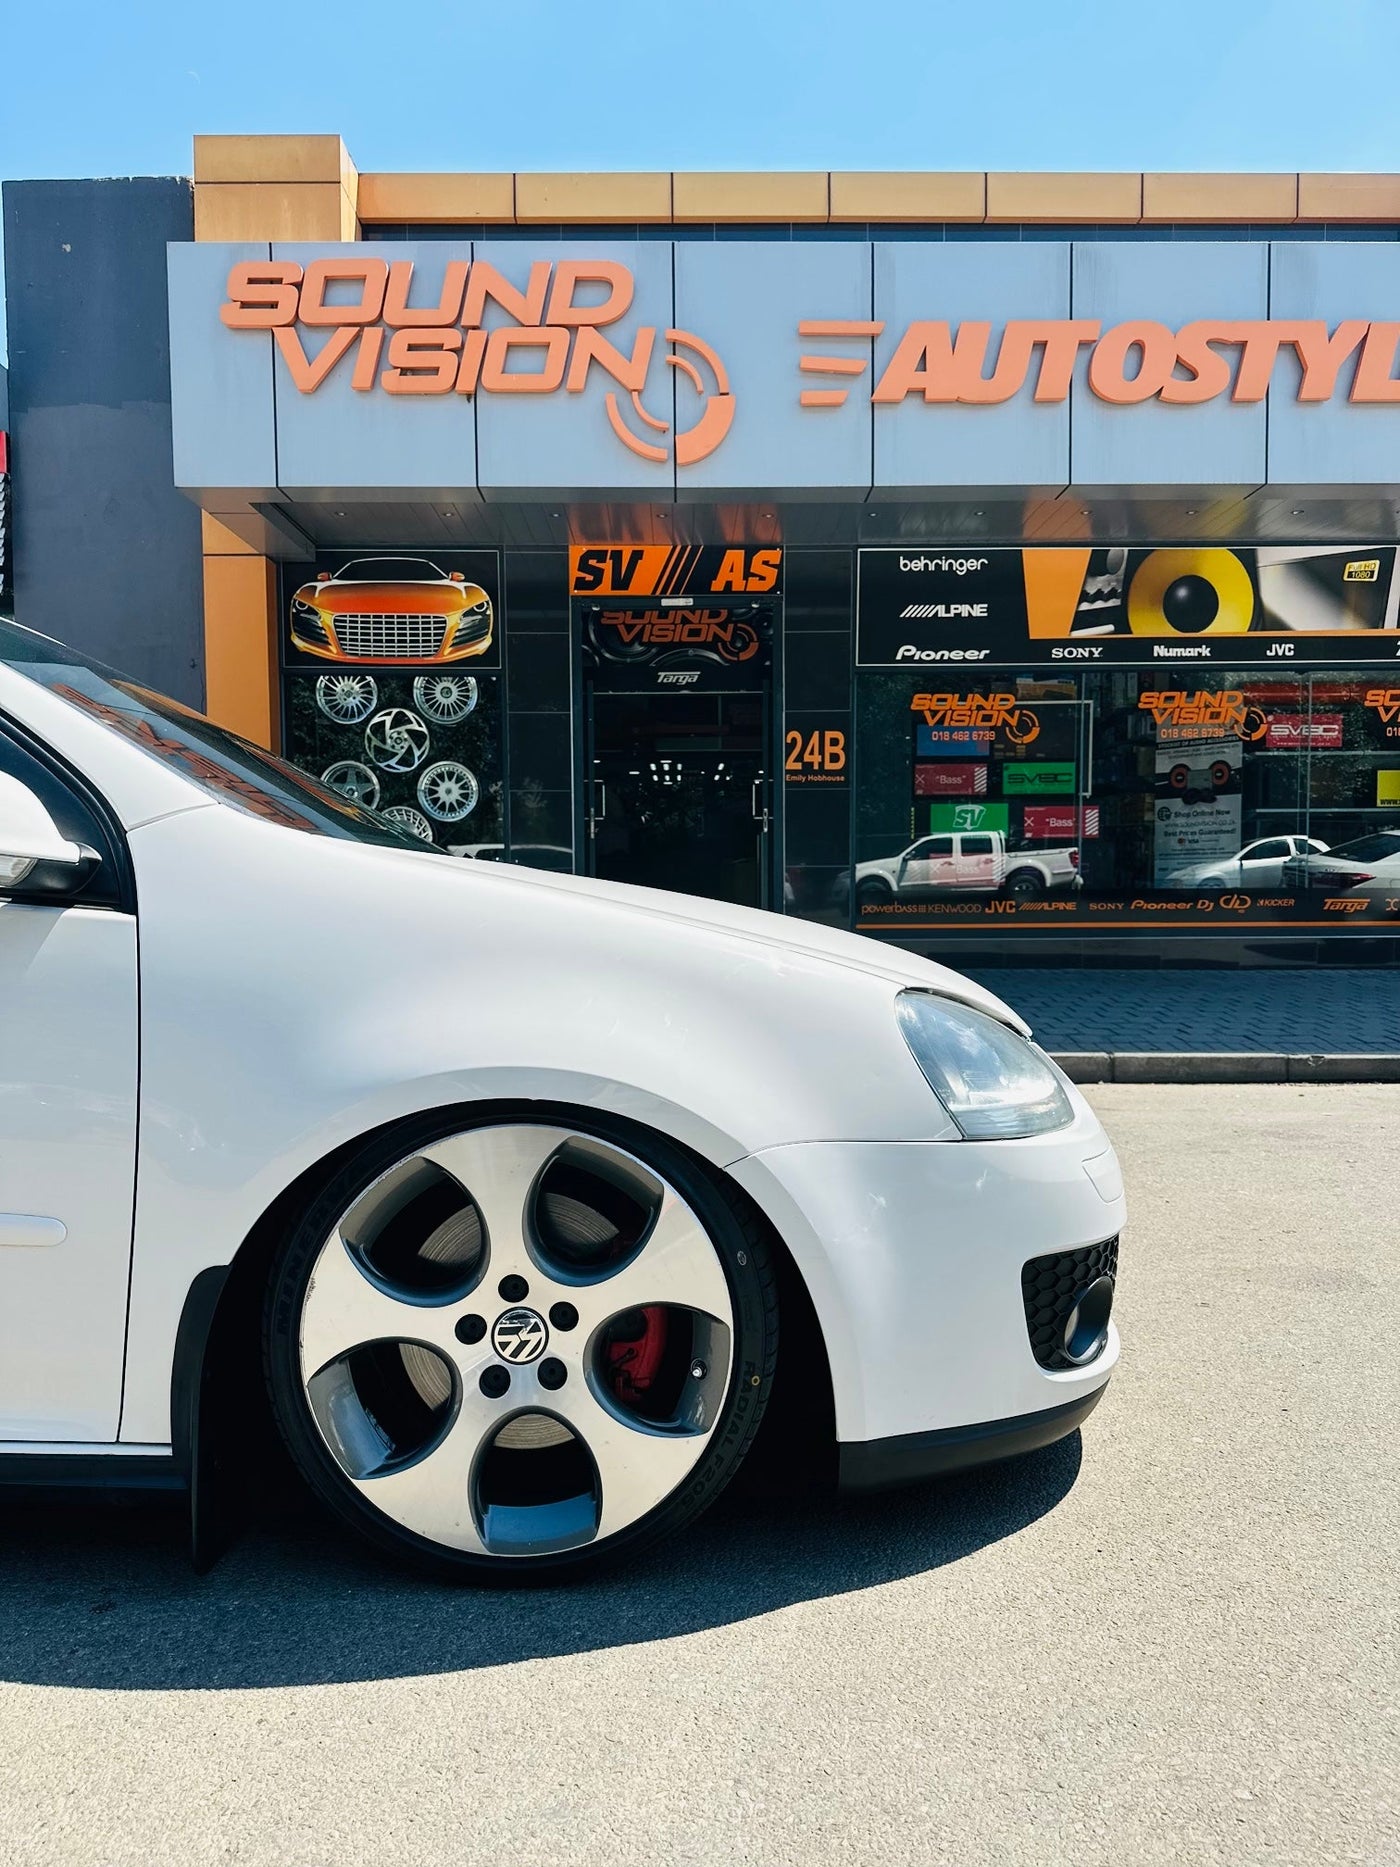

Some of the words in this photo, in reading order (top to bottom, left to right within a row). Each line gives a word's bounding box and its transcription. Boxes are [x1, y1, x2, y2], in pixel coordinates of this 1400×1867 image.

[219, 257, 634, 328] SOUND
[272, 325, 656, 394] VISION
[871, 320, 1400, 405] AUTOSTYL
[573, 549, 644, 591] SV
[710, 549, 783, 592] AS
[899, 556, 988, 575] behringer
[926, 603, 988, 617] ALPINE
[617, 624, 734, 642] VISION
[895, 645, 990, 661] Pioneer
[1051, 647, 1103, 658] SONY
[1153, 645, 1211, 657] Numark
[1266, 643, 1295, 656] JVC
[657, 671, 701, 685] Targa
[910, 693, 1016, 710] SOUND
[1138, 690, 1244, 708] SOUND
[923, 710, 1020, 726] VISION
[1151, 707, 1248, 724] VISION
[931, 731, 950, 740] 018
[952, 731, 970, 740] 462
[972, 731, 996, 740] 6739
[1160, 728, 1179, 739] 018
[785, 730, 846, 770] 24B
[785, 774, 806, 783] Emily
[953, 808, 986, 828] SV
[1174, 811, 1191, 819] Shop
[1192, 809, 1214, 817] Online
[927, 903, 982, 913] KENWOOD
[984, 900, 1016, 913] JVC
[1036, 902, 1077, 911] ALPINE
[1088, 902, 1125, 910] SONY
[1130, 899, 1193, 910] Pioneer
[1264, 898, 1295, 906] KICKER
[1323, 898, 1371, 913] Targa
[720, 1359, 756, 1447] RADIAL
